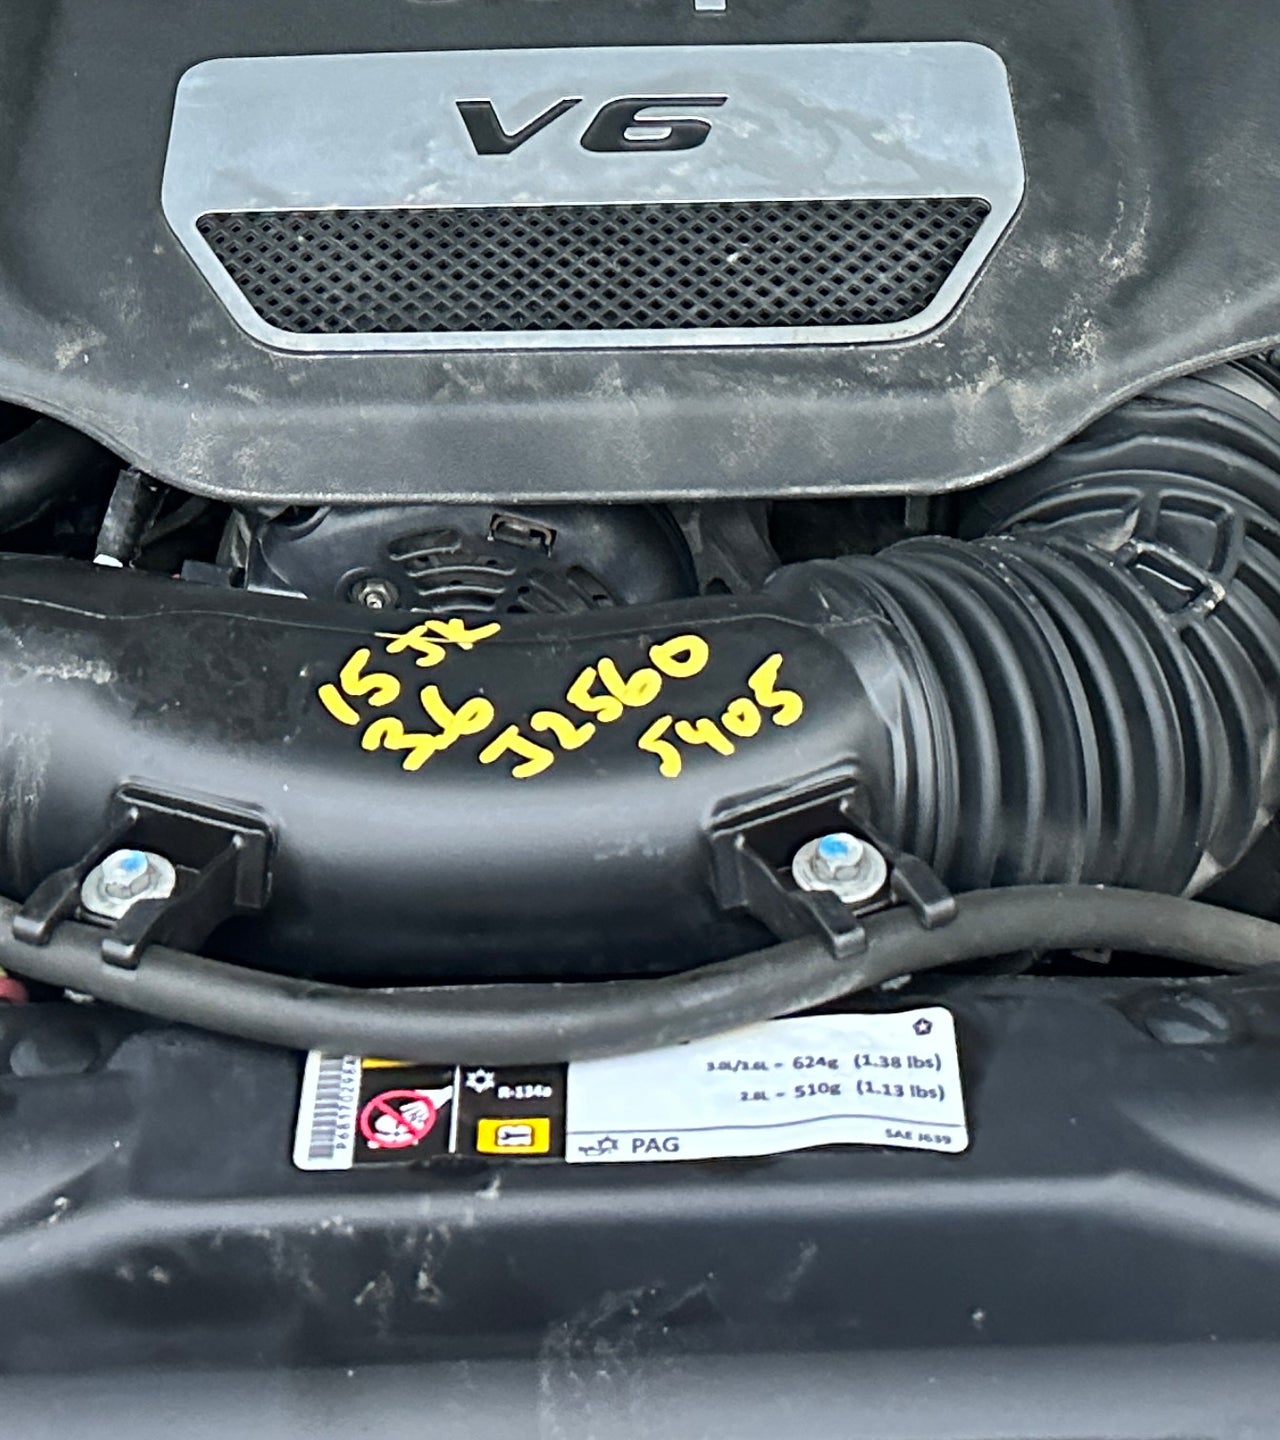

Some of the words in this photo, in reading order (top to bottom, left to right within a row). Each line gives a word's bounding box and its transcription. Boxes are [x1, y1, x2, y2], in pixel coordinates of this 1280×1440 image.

[456, 95, 729, 155] V6
[318, 648, 401, 726] 15
[638, 653, 803, 778] 5405
[792, 1056, 840, 1070] 624g
[853, 1053, 902, 1070] (1.38
[907, 1053, 942, 1072] lbs)
[794, 1081, 842, 1098] 510g
[856, 1080, 905, 1098] (1.13
[910, 1085, 946, 1103] lbs)
[631, 1137, 681, 1155] PAG
[885, 1128, 913, 1141] SAE
